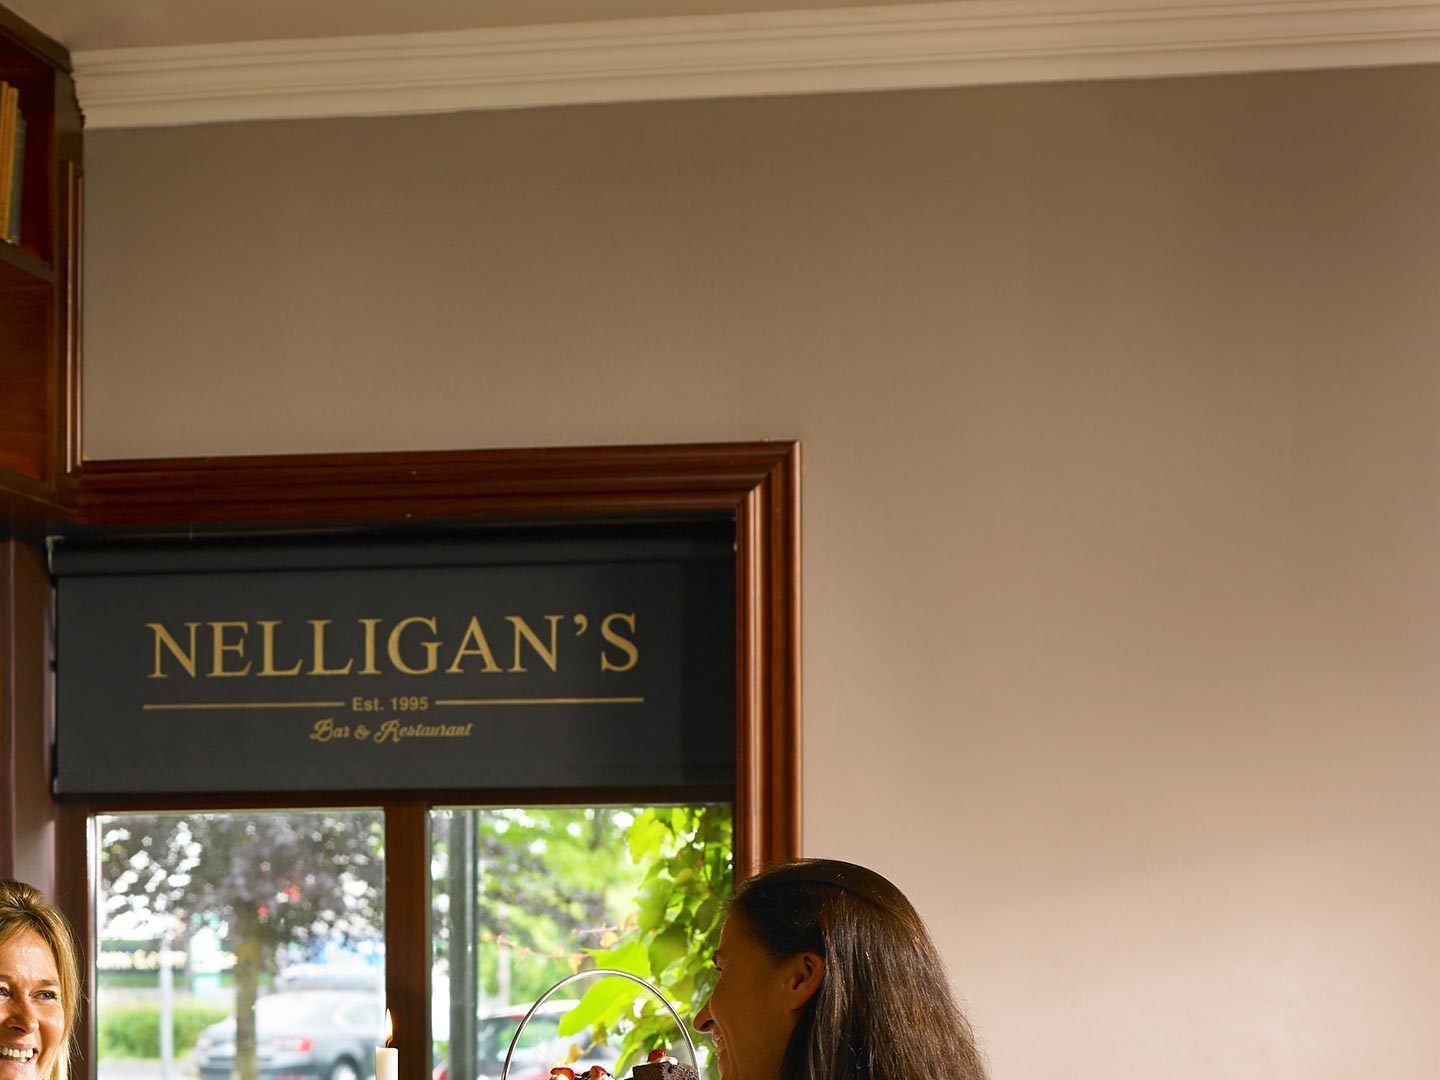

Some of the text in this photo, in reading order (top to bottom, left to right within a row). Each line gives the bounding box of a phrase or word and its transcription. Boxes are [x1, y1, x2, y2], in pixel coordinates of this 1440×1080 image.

[144, 612, 641, 679] NELLIGAN’S
[351, 696, 429, 712] Est. 1995
[310, 717, 474, 743] Bar & Restaurant
